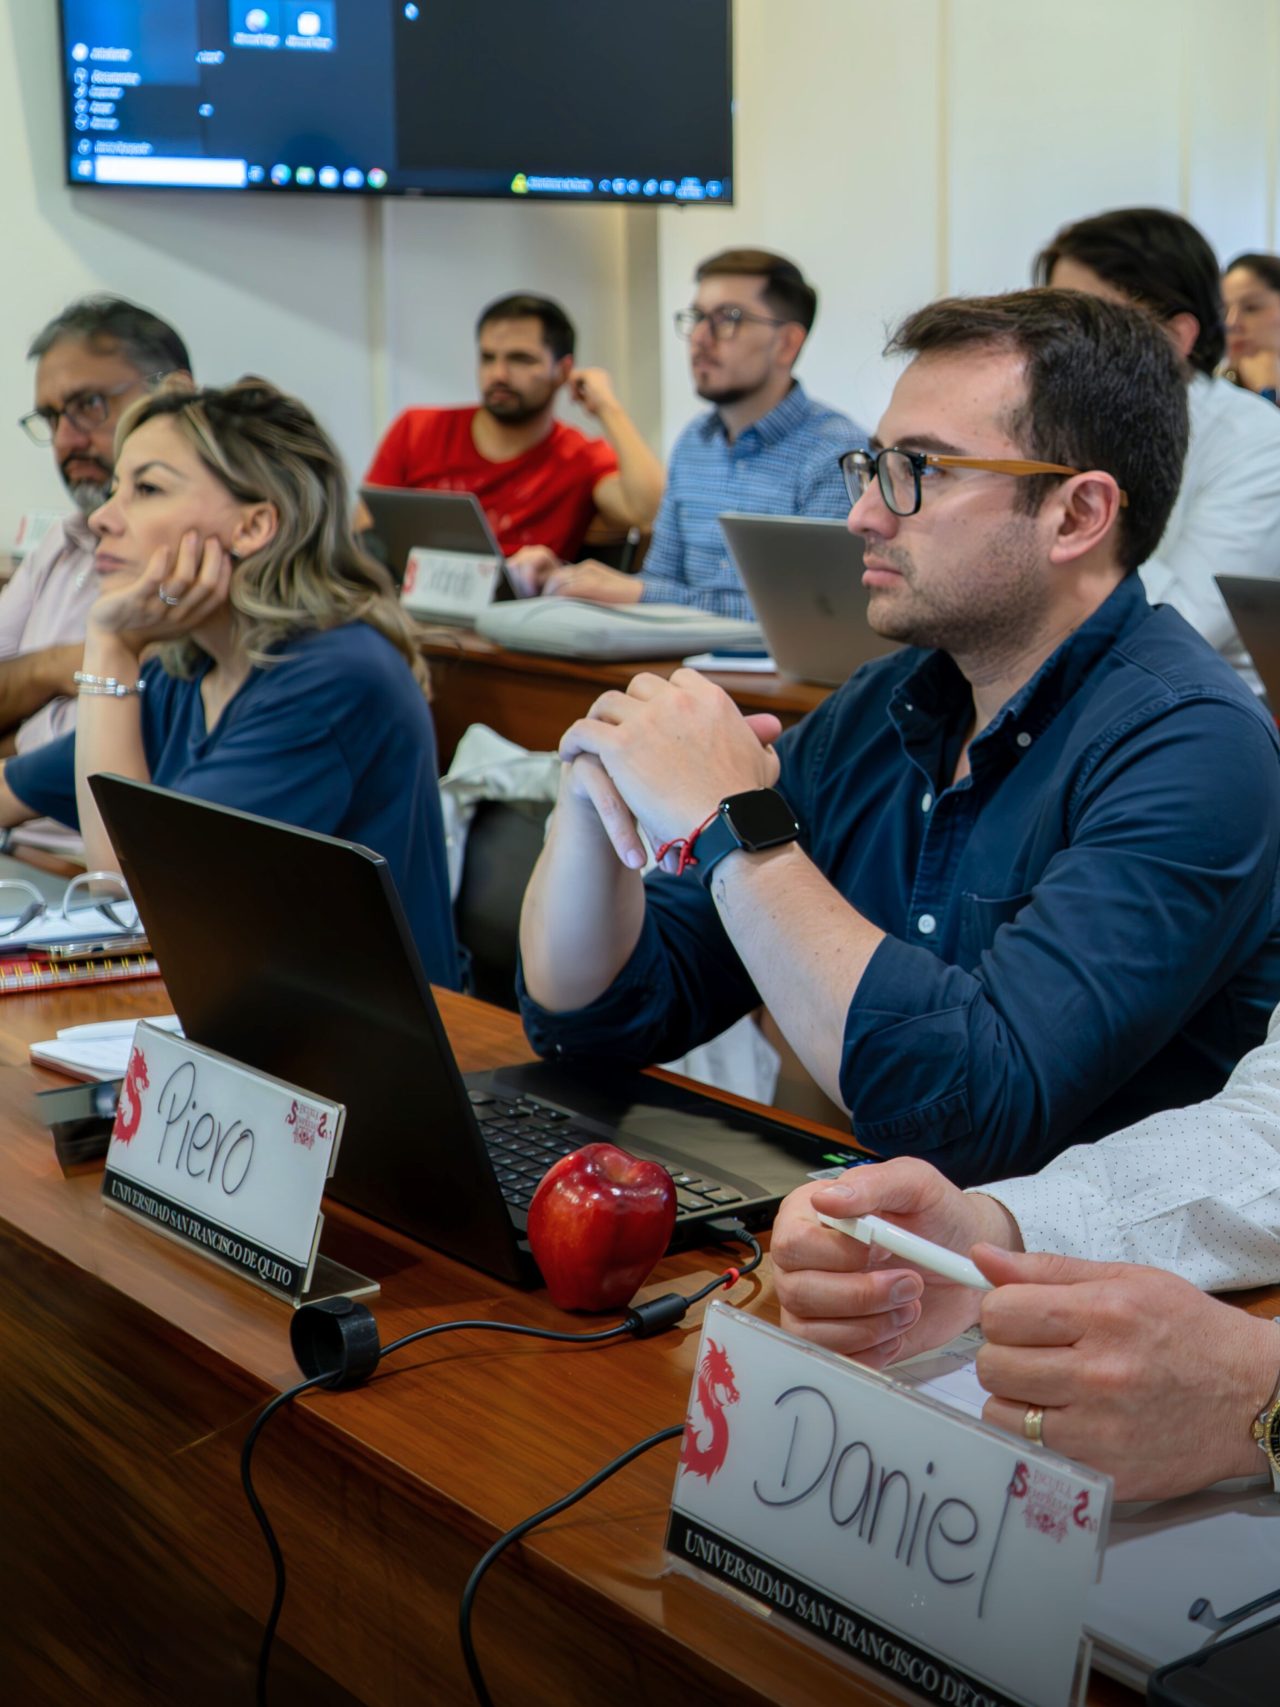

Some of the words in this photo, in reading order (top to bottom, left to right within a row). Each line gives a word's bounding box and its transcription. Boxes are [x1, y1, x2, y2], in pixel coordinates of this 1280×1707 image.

[156, 1060, 256, 1196] Piero
[111, 1179, 171, 1223] UNIVERSIDAD
[170, 1209, 190, 1233] SAN
[188, 1218, 243, 1261] FRANCISCO
[242, 1247, 258, 1269] DE
[257, 1255, 292, 1287] QUITO
[752, 1385, 1020, 1618] Daniel
[684, 1528, 796, 1609] UNIVERSIDAD
[795, 1593, 833, 1631] SAN
[831, 1613, 940, 1692] FRANCISCO
[940, 1674, 972, 1707] DE
